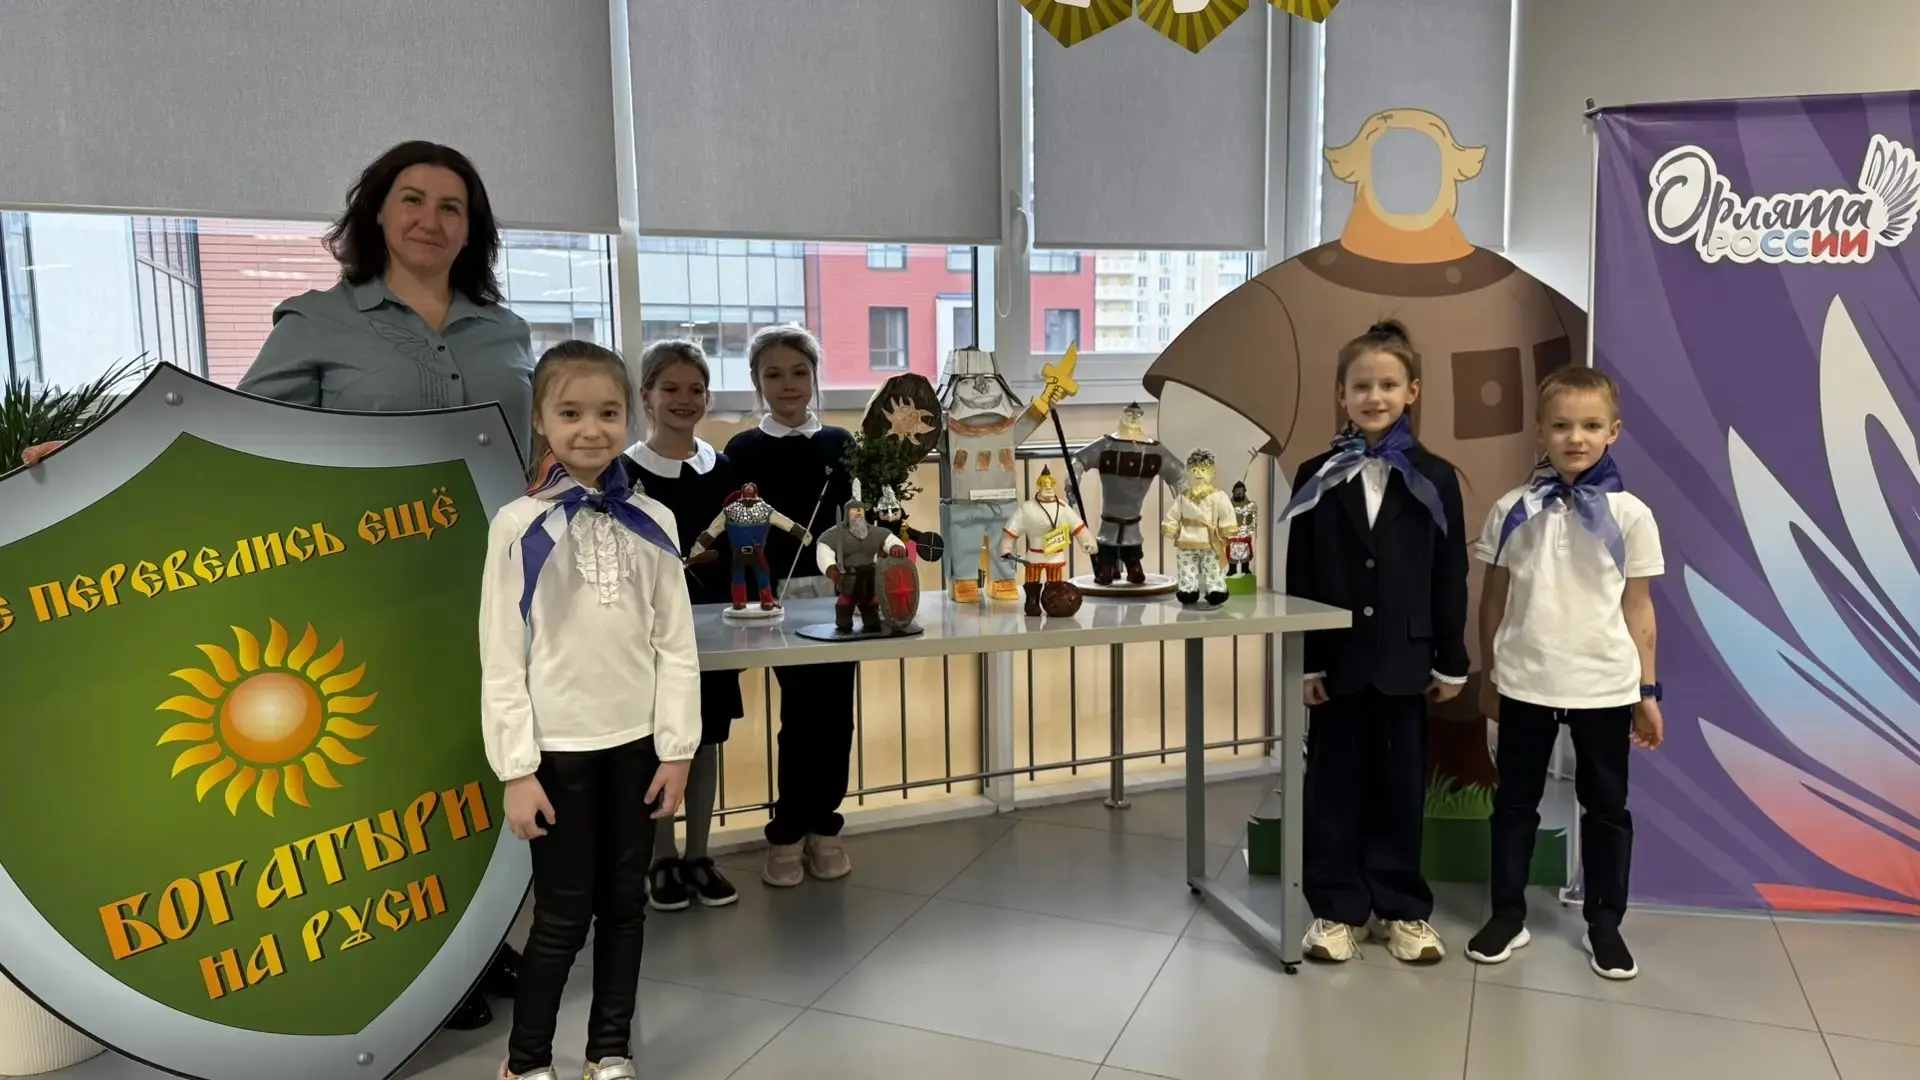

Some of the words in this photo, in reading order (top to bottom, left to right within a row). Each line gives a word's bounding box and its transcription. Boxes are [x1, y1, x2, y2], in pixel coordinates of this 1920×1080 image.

[1654, 151, 1872, 247] Орлята
[1707, 229, 1869, 258] РОССИИ
[29, 522, 347, 622] ПЕРЕВЕЛИСЬ
[358, 486, 459, 543] ЕЩЁ
[99, 781, 493, 960] БОГАТЫРИ
[199, 934, 286, 999] НА
[302, 874, 446, 962] РУСИ
